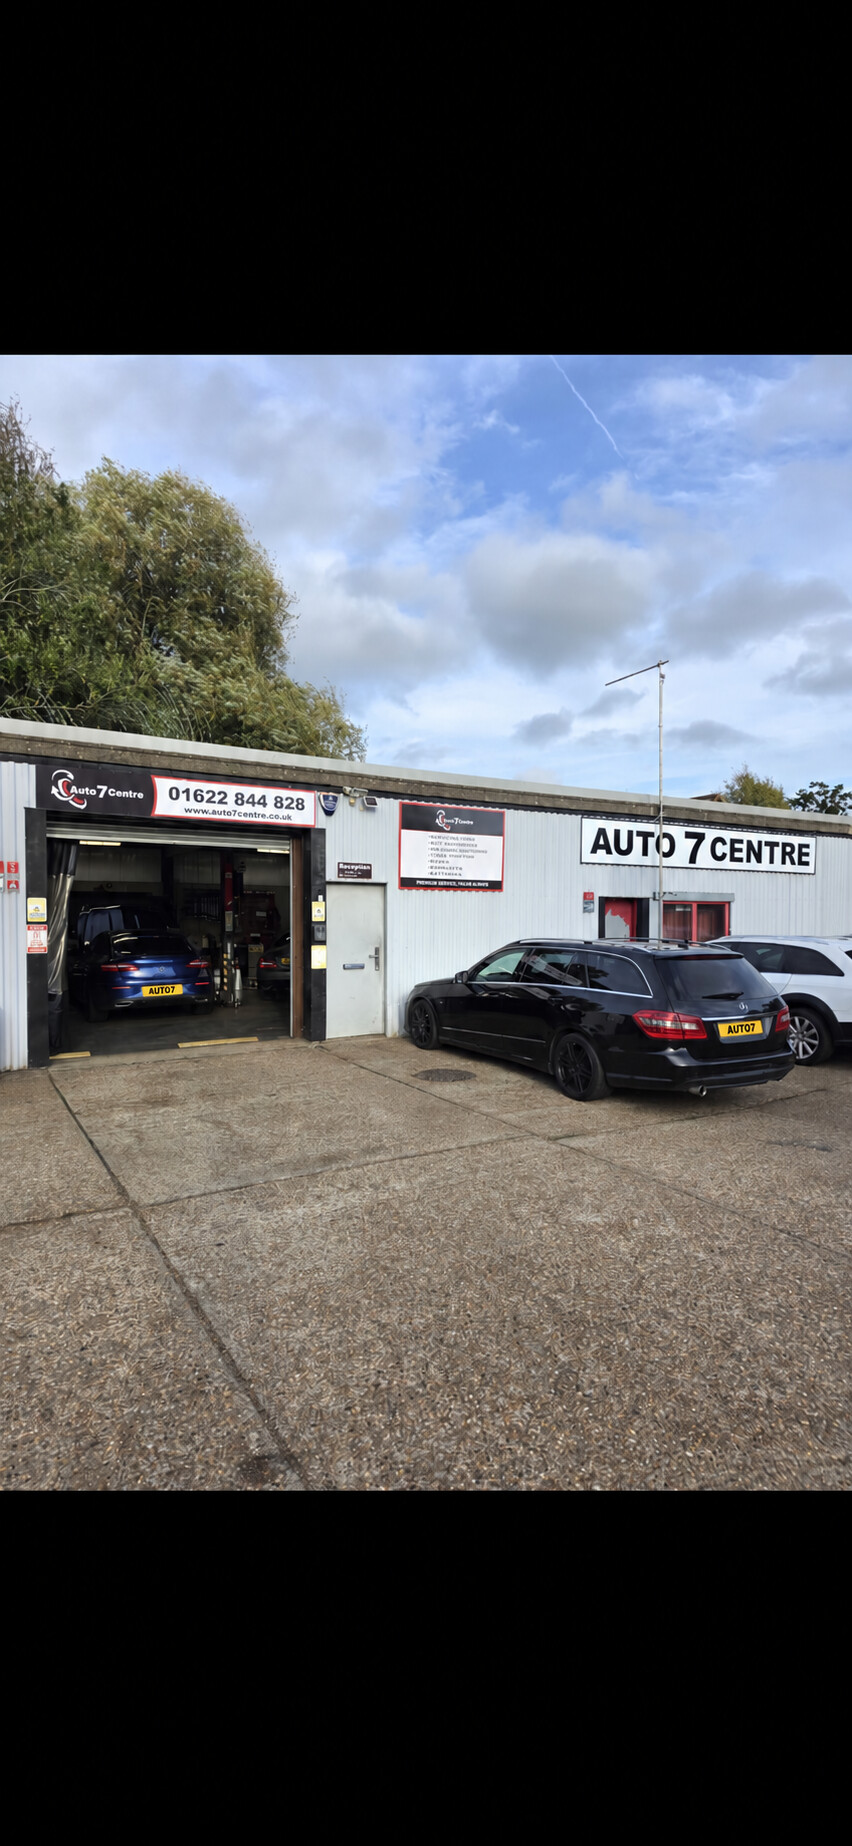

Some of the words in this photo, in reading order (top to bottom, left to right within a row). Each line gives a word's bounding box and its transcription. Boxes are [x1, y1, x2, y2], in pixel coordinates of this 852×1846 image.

[70, 785, 97, 796] Auto
[108, 788, 144, 799] Centre
[168, 786, 228, 805] 01622
[234, 792, 268, 808] 844
[273, 795, 306, 811] 828
[184, 808, 292, 820] www.auto7centre.co.uk
[590, 827, 676, 858] AUTO
[684, 831, 706, 865] 7
[710, 836, 810, 867] CENTRE
[148, 986, 176, 994] AUTO7
[728, 1023, 756, 1034] AUTO7
